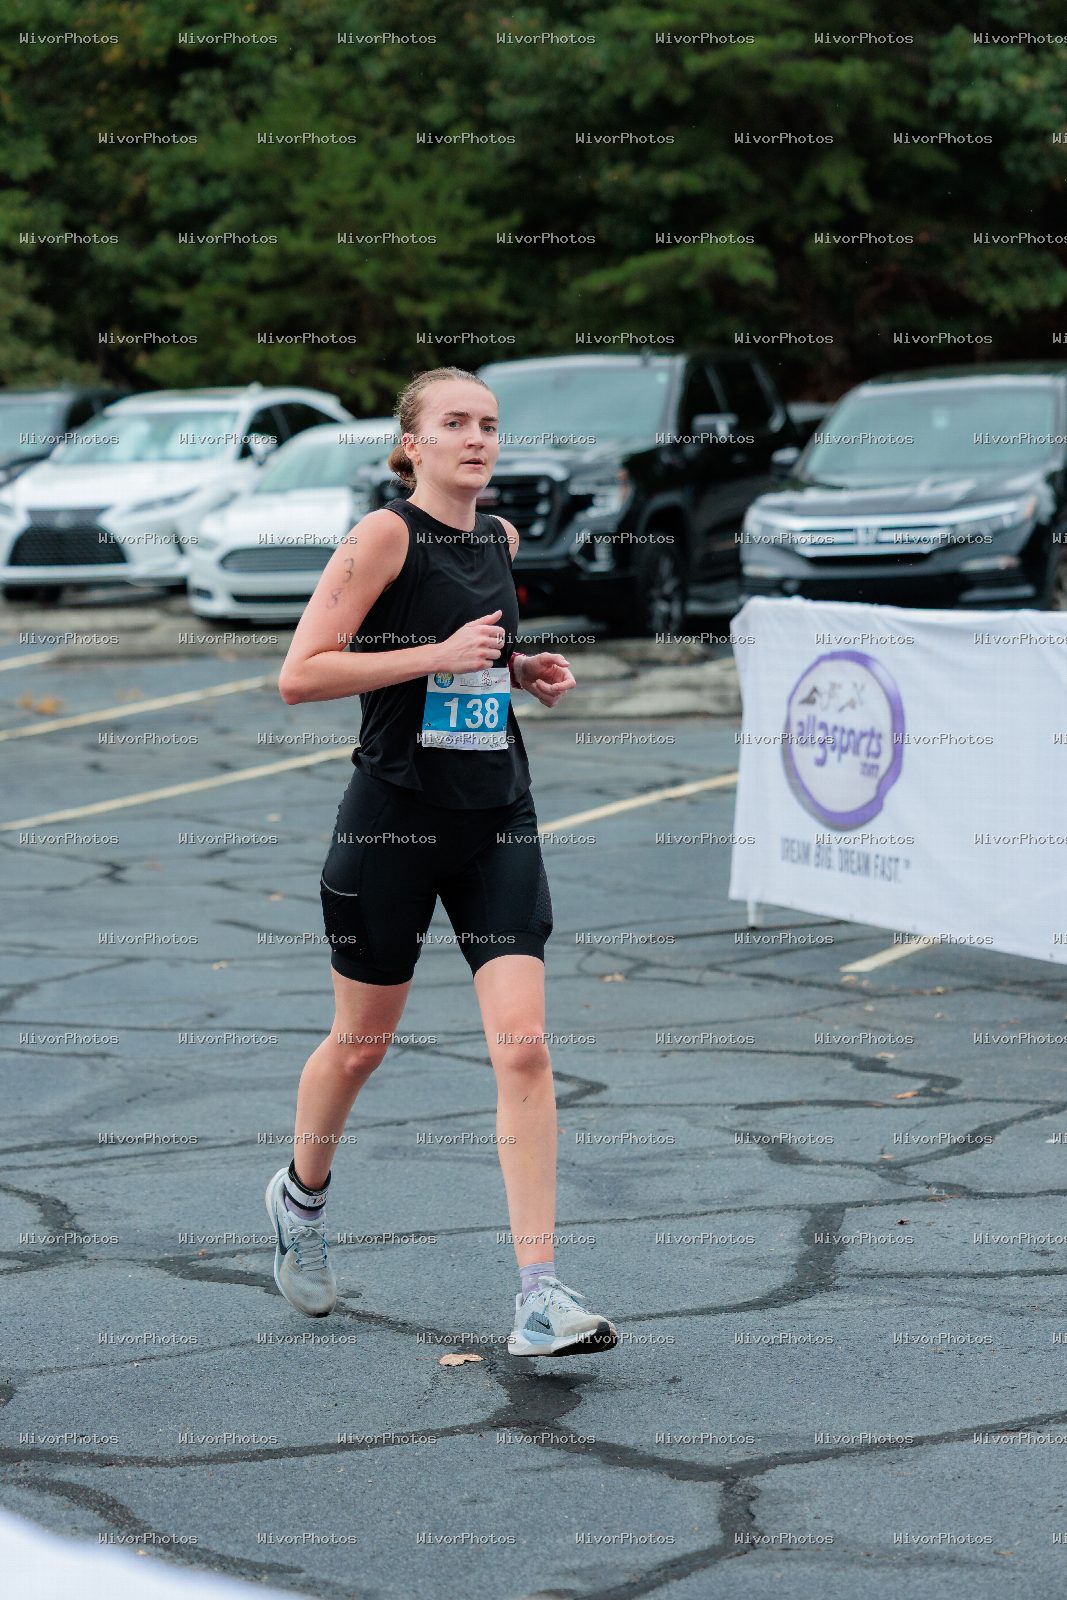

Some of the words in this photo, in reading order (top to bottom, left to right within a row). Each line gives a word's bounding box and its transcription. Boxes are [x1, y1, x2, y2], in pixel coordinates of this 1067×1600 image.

[443, 697, 500, 729] 138
[796, 713, 883, 768] all3sports
[838, 847, 871, 878] DREAM
